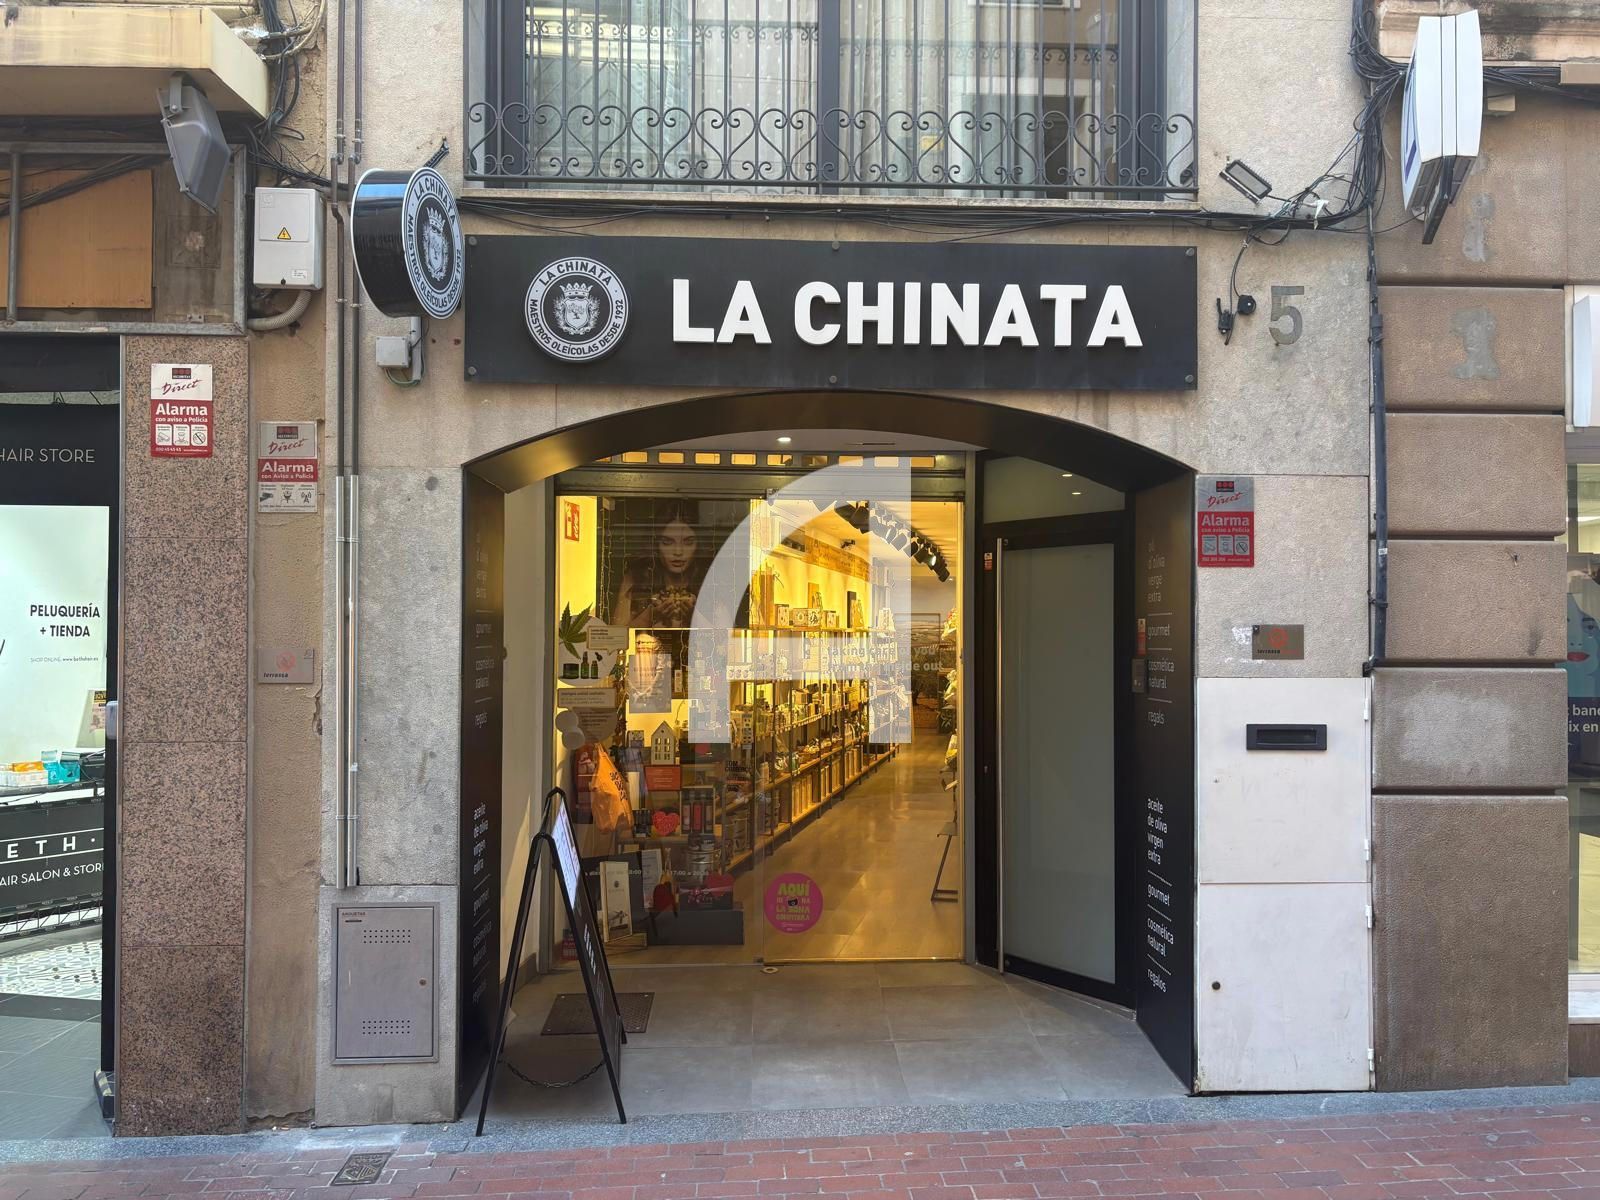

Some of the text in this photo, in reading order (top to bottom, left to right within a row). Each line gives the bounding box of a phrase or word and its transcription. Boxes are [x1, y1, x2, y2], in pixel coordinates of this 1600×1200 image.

[413, 177, 456, 225] LA CHINATA
[408, 214, 421, 283] MAESTROS
[539, 261, 612, 286] LA CHINATA
[672, 278, 1144, 347] LA CHINATA
[1268, 285, 1305, 345] 5
[530, 299, 624, 356] MAESTROS OLEÍCOLAS DESDE 1932
[162, 379, 204, 396] Direct
[155, 402, 208, 416] Alarma
[39, 448, 95, 462] STORE
[267, 438, 309, 455] Direct
[261, 461, 314, 473] Alarma
[1207, 492, 1243, 508] Direct
[1201, 514, 1249, 527] Alarma
[30, 603, 101, 618] PELUQUERÍA
[40, 625, 91, 637] + TIENDA
[914, 647, 937, 659] you
[925, 661, 944, 671] out
[1582, 723, 1599, 733] en
[1147, 797, 1164, 814] aceite
[1147, 814, 1168, 834] de oliva
[1147, 831, 1164, 850] virgen
[1147, 849, 1161, 865] extra
[21, 868, 61, 884] SALON
[63, 867, 71, 877] &
[73, 862, 104, 876] STOR
[1147, 883, 1170, 907] gourmet
[1147, 917, 1174, 945] cosmética
[1147, 933, 1166, 957] natural
[1147, 967, 1167, 993] regalos
